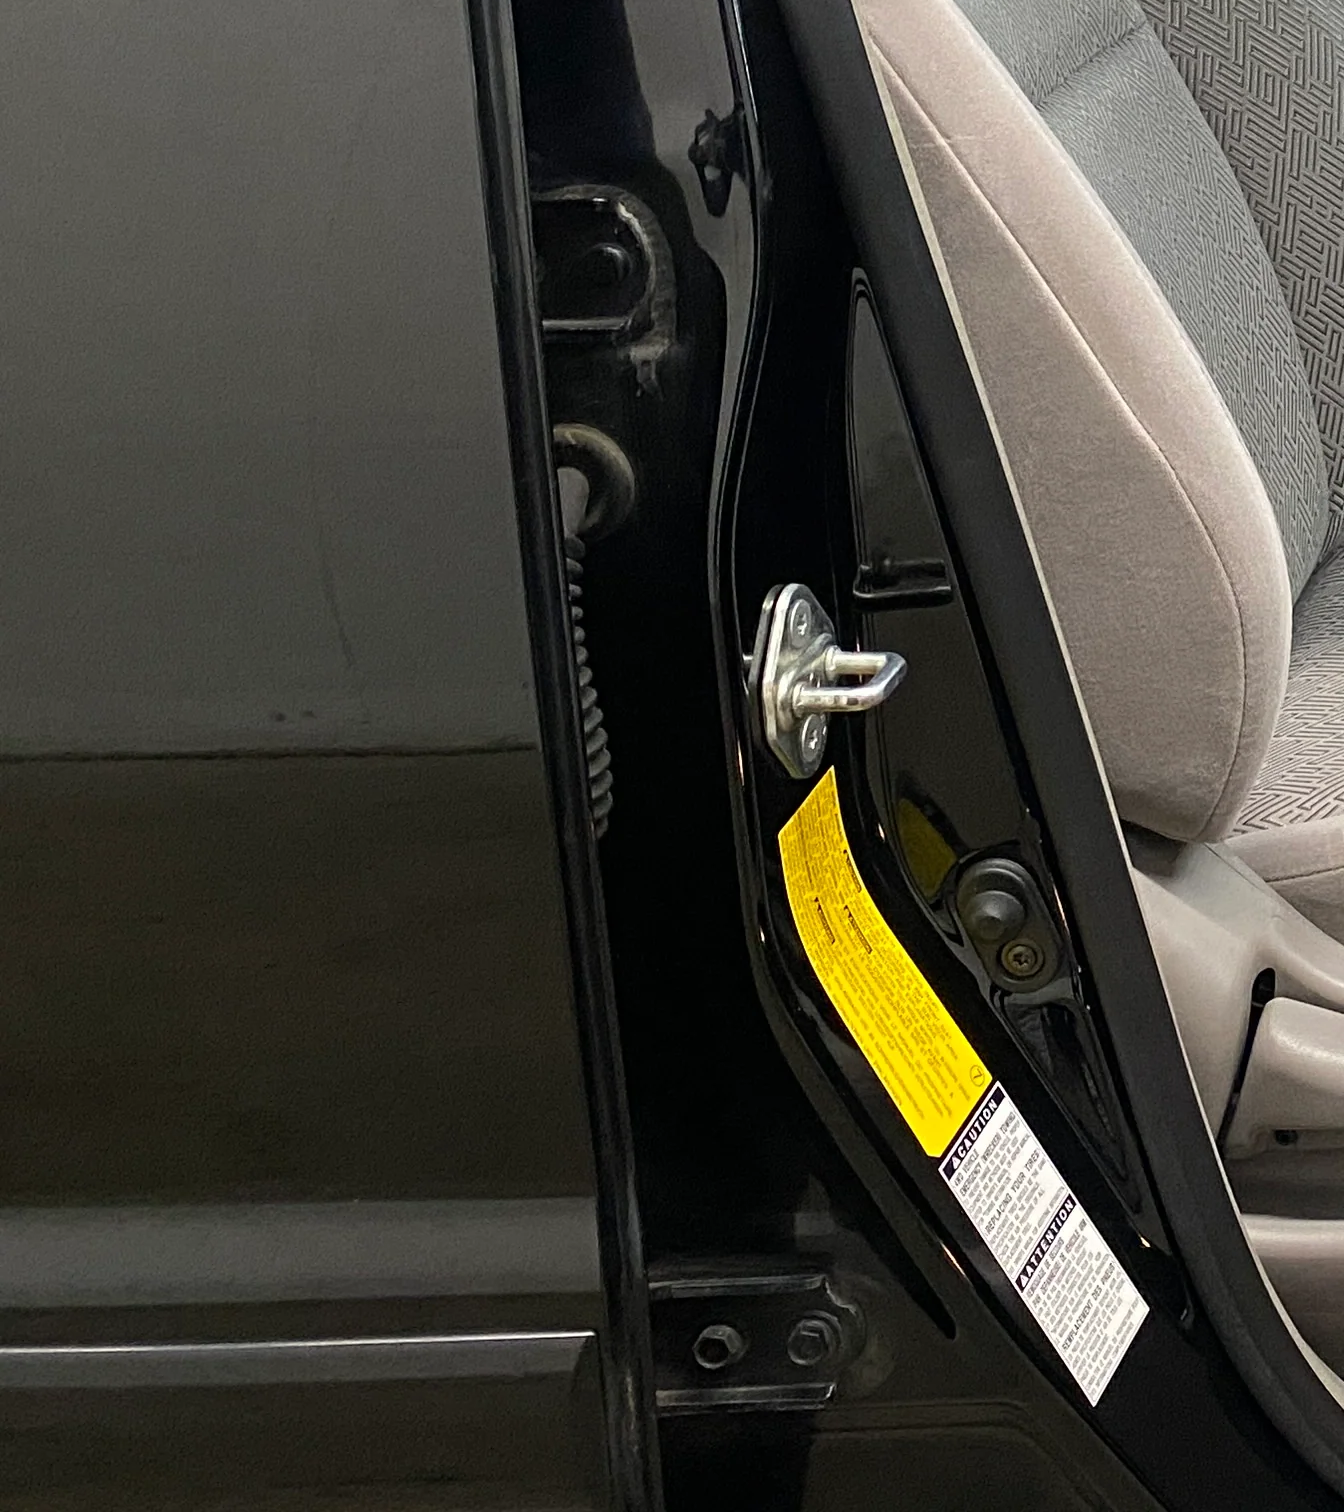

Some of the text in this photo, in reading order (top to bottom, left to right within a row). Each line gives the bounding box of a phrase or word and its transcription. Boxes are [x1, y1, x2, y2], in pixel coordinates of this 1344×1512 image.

[956, 1097, 998, 1159] CAUTION
[984, 1148, 1040, 1235] REPLACING YOUR TIRES
[1024, 1197, 1073, 1278] ATTENTION
[1061, 1298, 1093, 1353] REMPLACEMENT
[1091, 1283, 1102, 1301] DES
